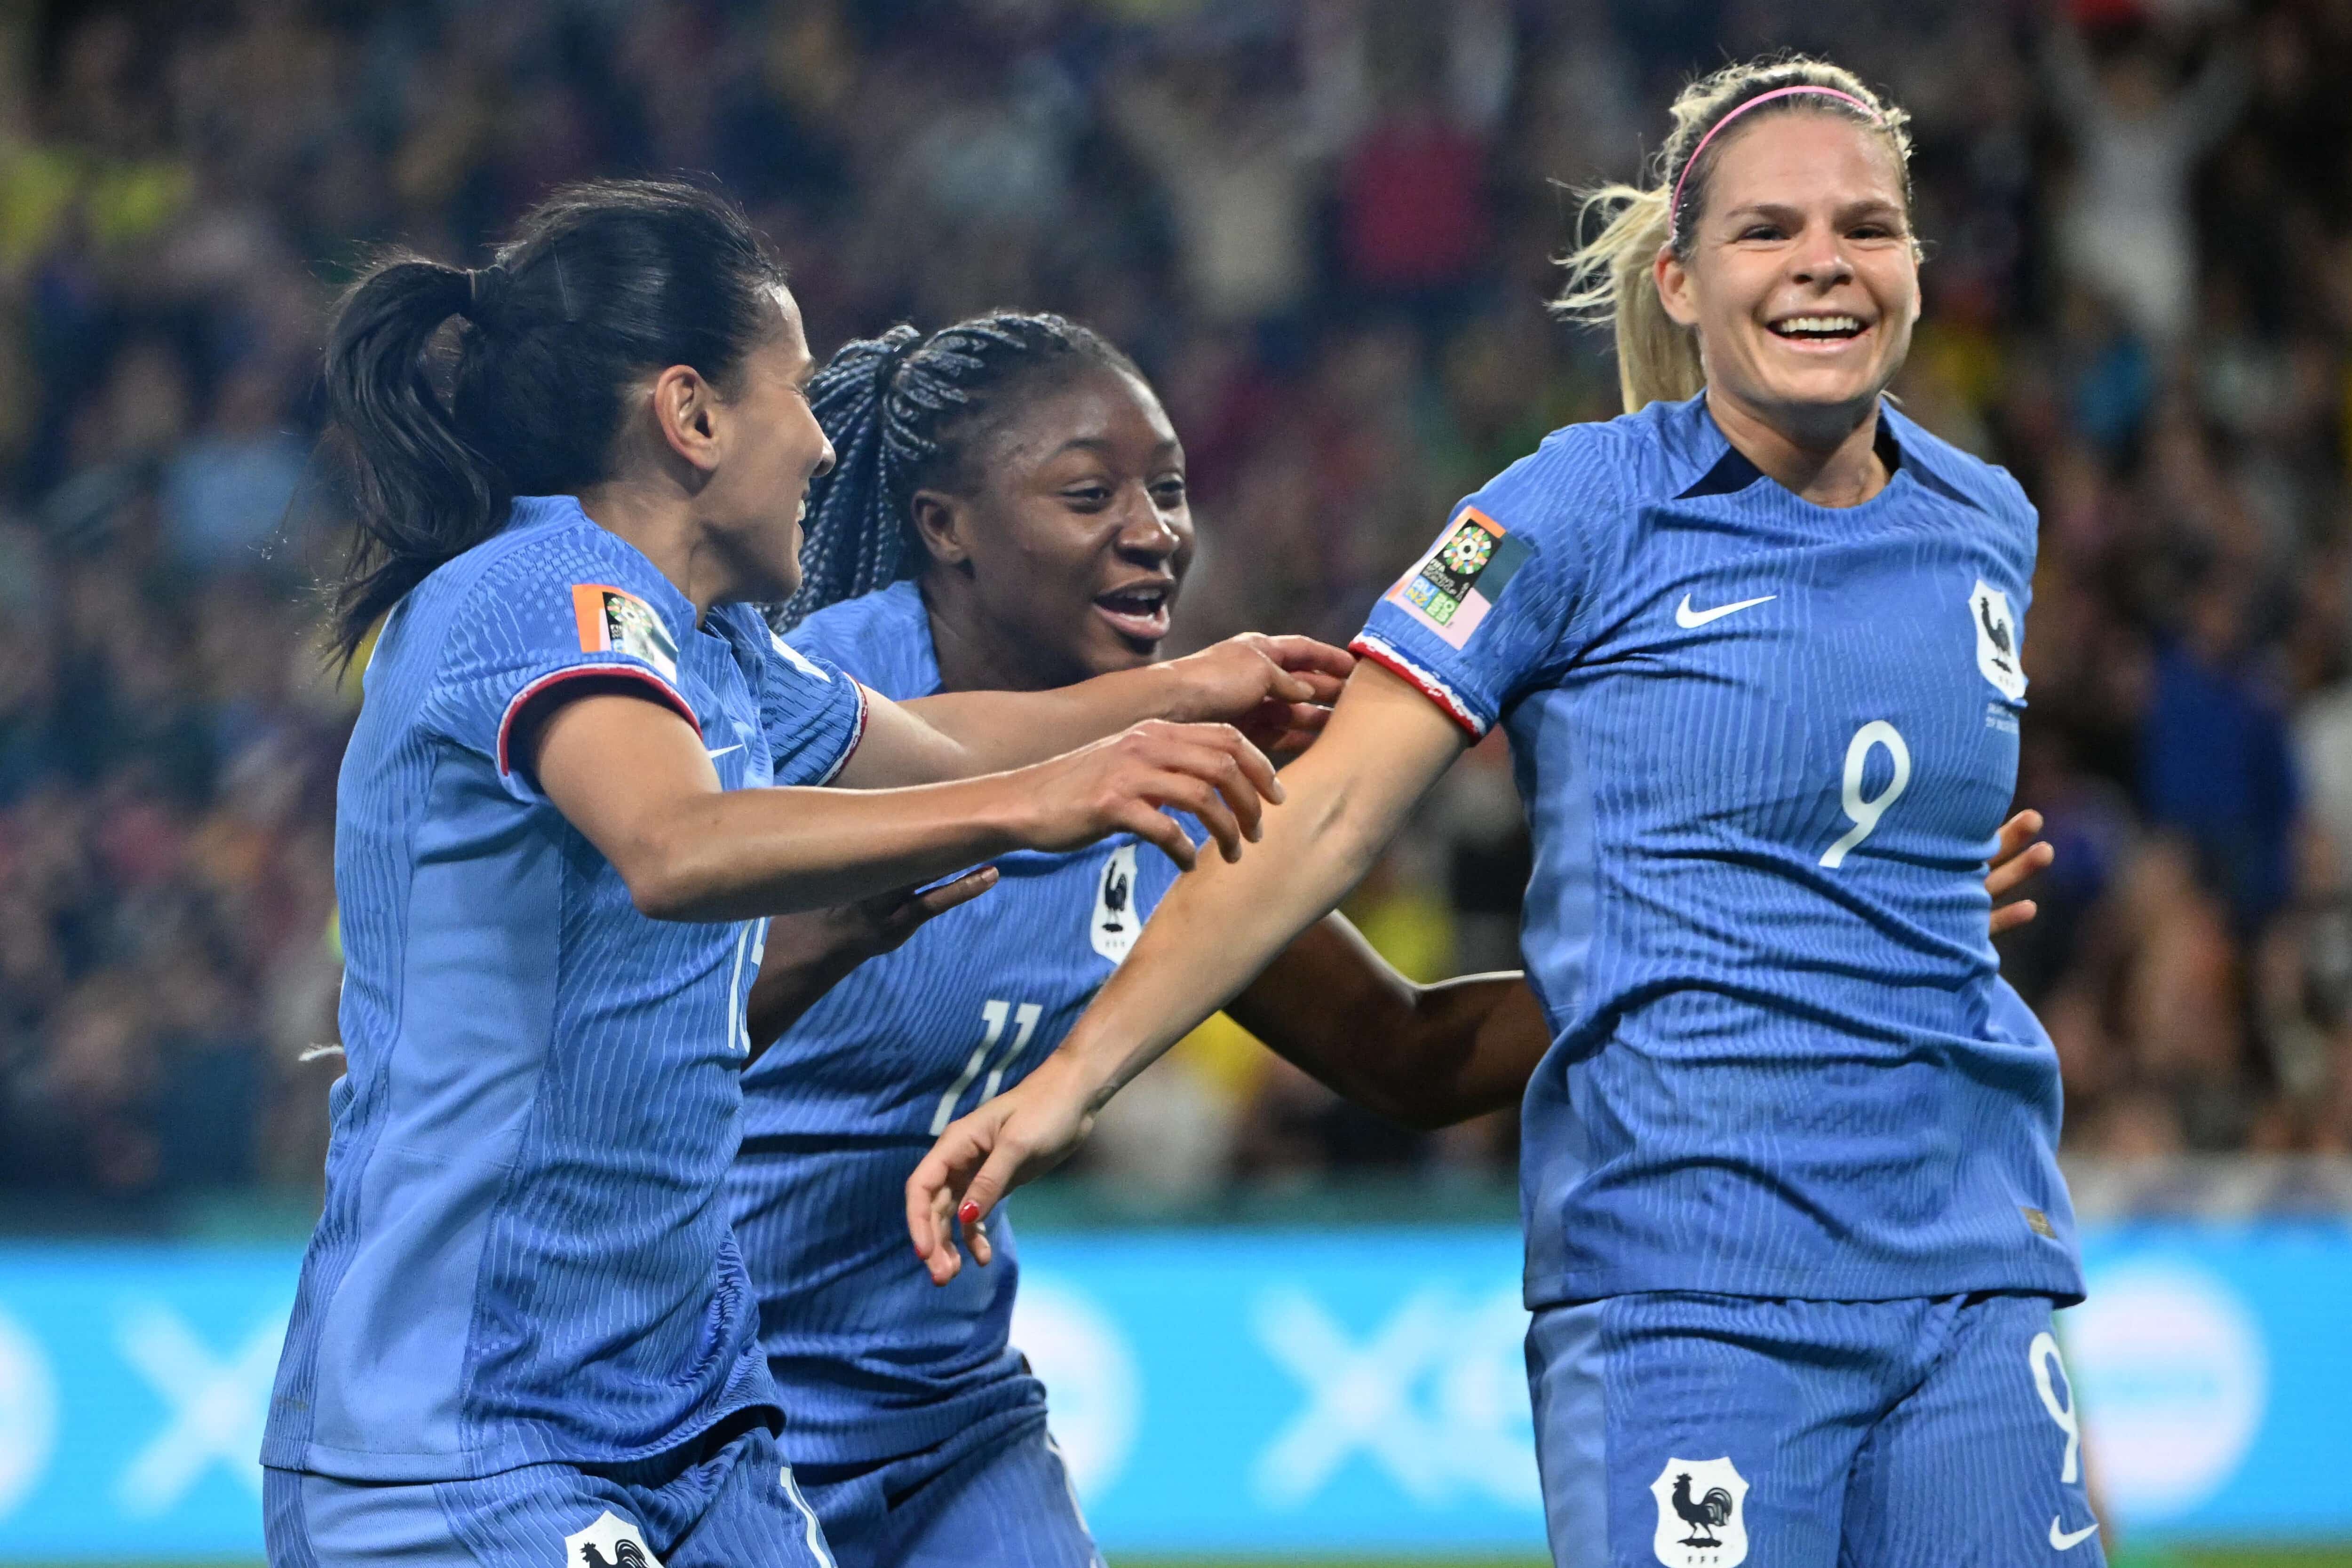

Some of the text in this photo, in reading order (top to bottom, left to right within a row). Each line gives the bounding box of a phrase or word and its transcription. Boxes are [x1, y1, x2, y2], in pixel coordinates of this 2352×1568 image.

[1818, 720, 1910, 868] 9
[929, 999, 1043, 1136] 11
[2029, 1332, 2079, 1483] 9
